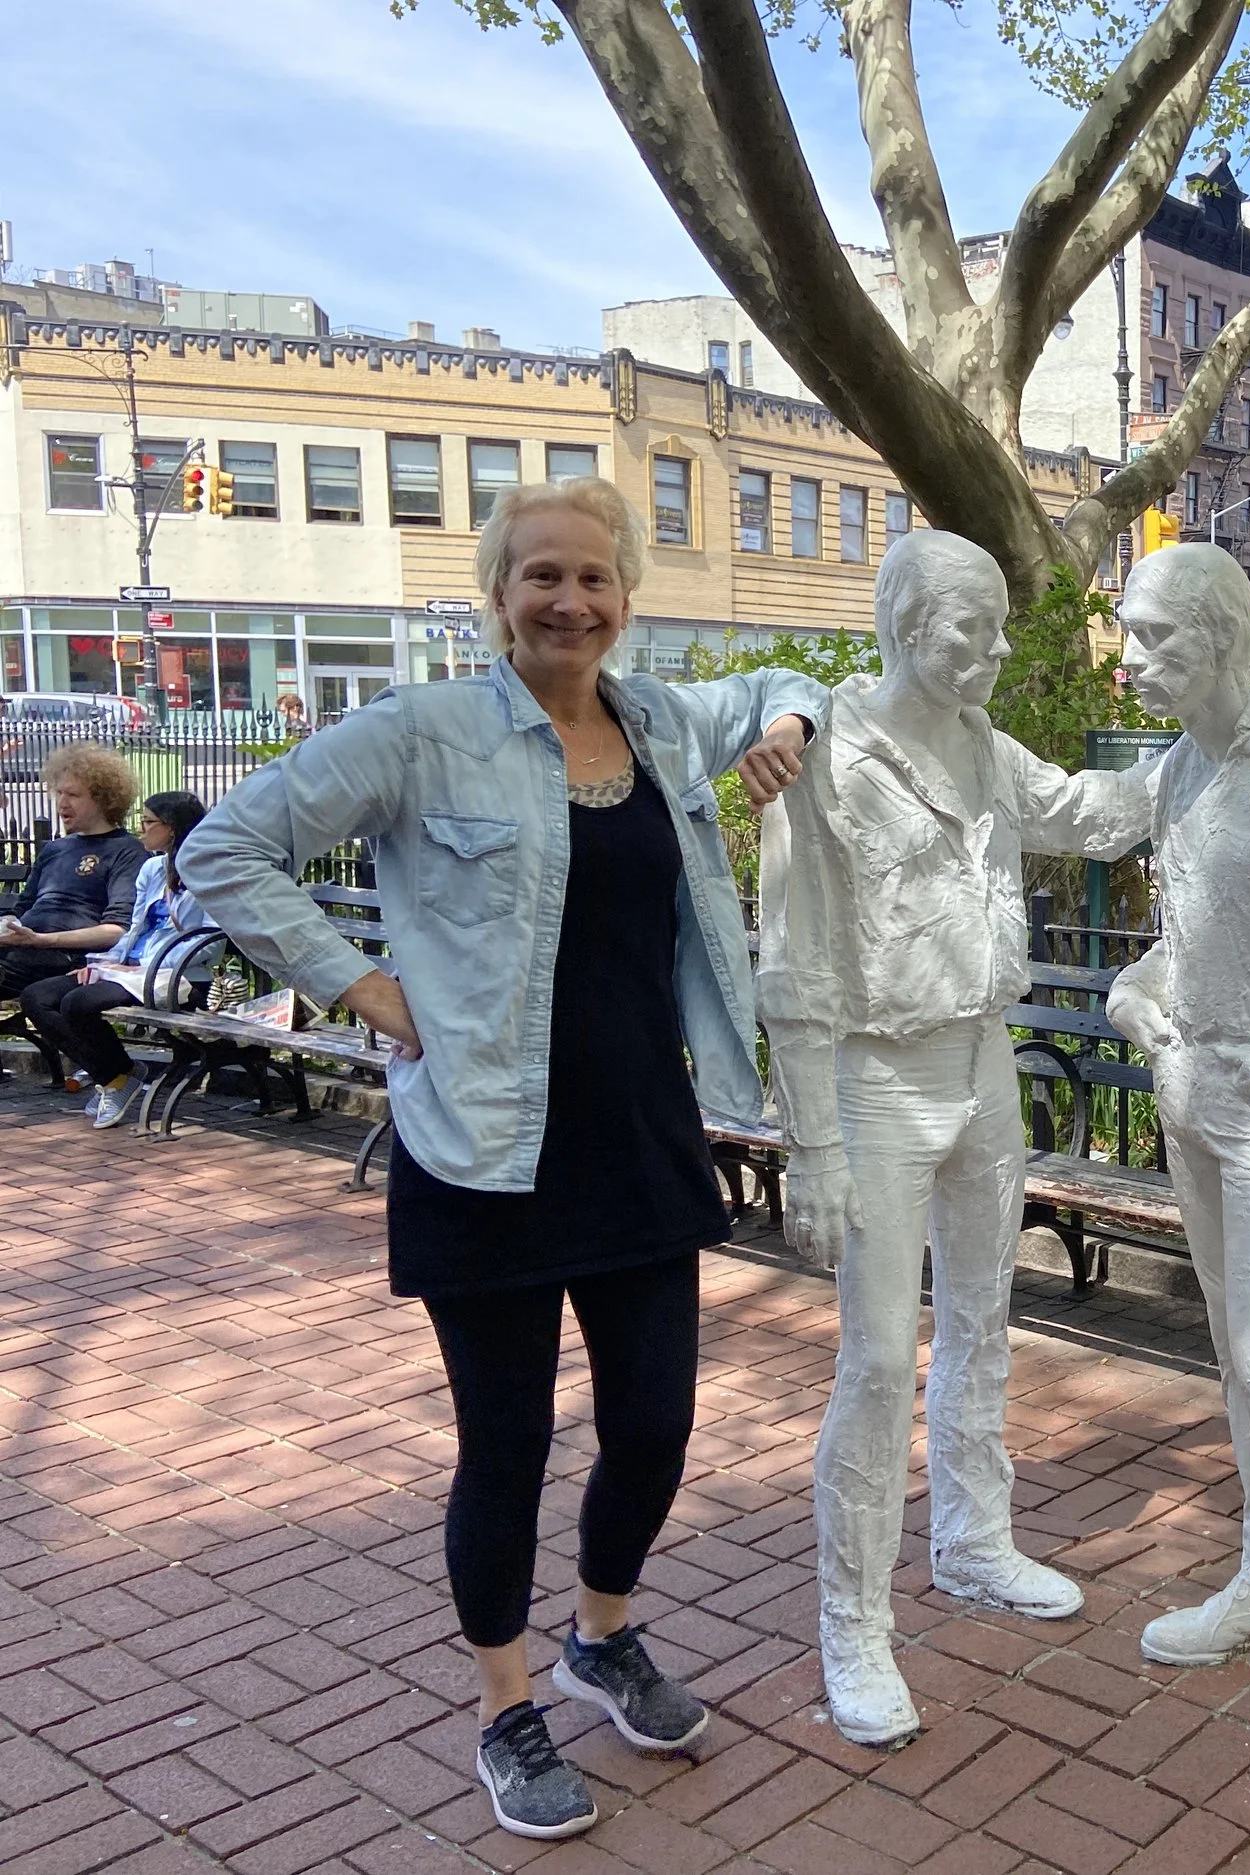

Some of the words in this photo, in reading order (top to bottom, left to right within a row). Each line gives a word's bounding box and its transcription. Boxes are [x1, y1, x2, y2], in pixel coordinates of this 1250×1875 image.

[1131, 447, 1145, 457] WES
[1096, 736, 1108, 745] GAY
[1108, 737, 1140, 745] LIBERATION
[1140, 737, 1175, 746] MONUMENT
